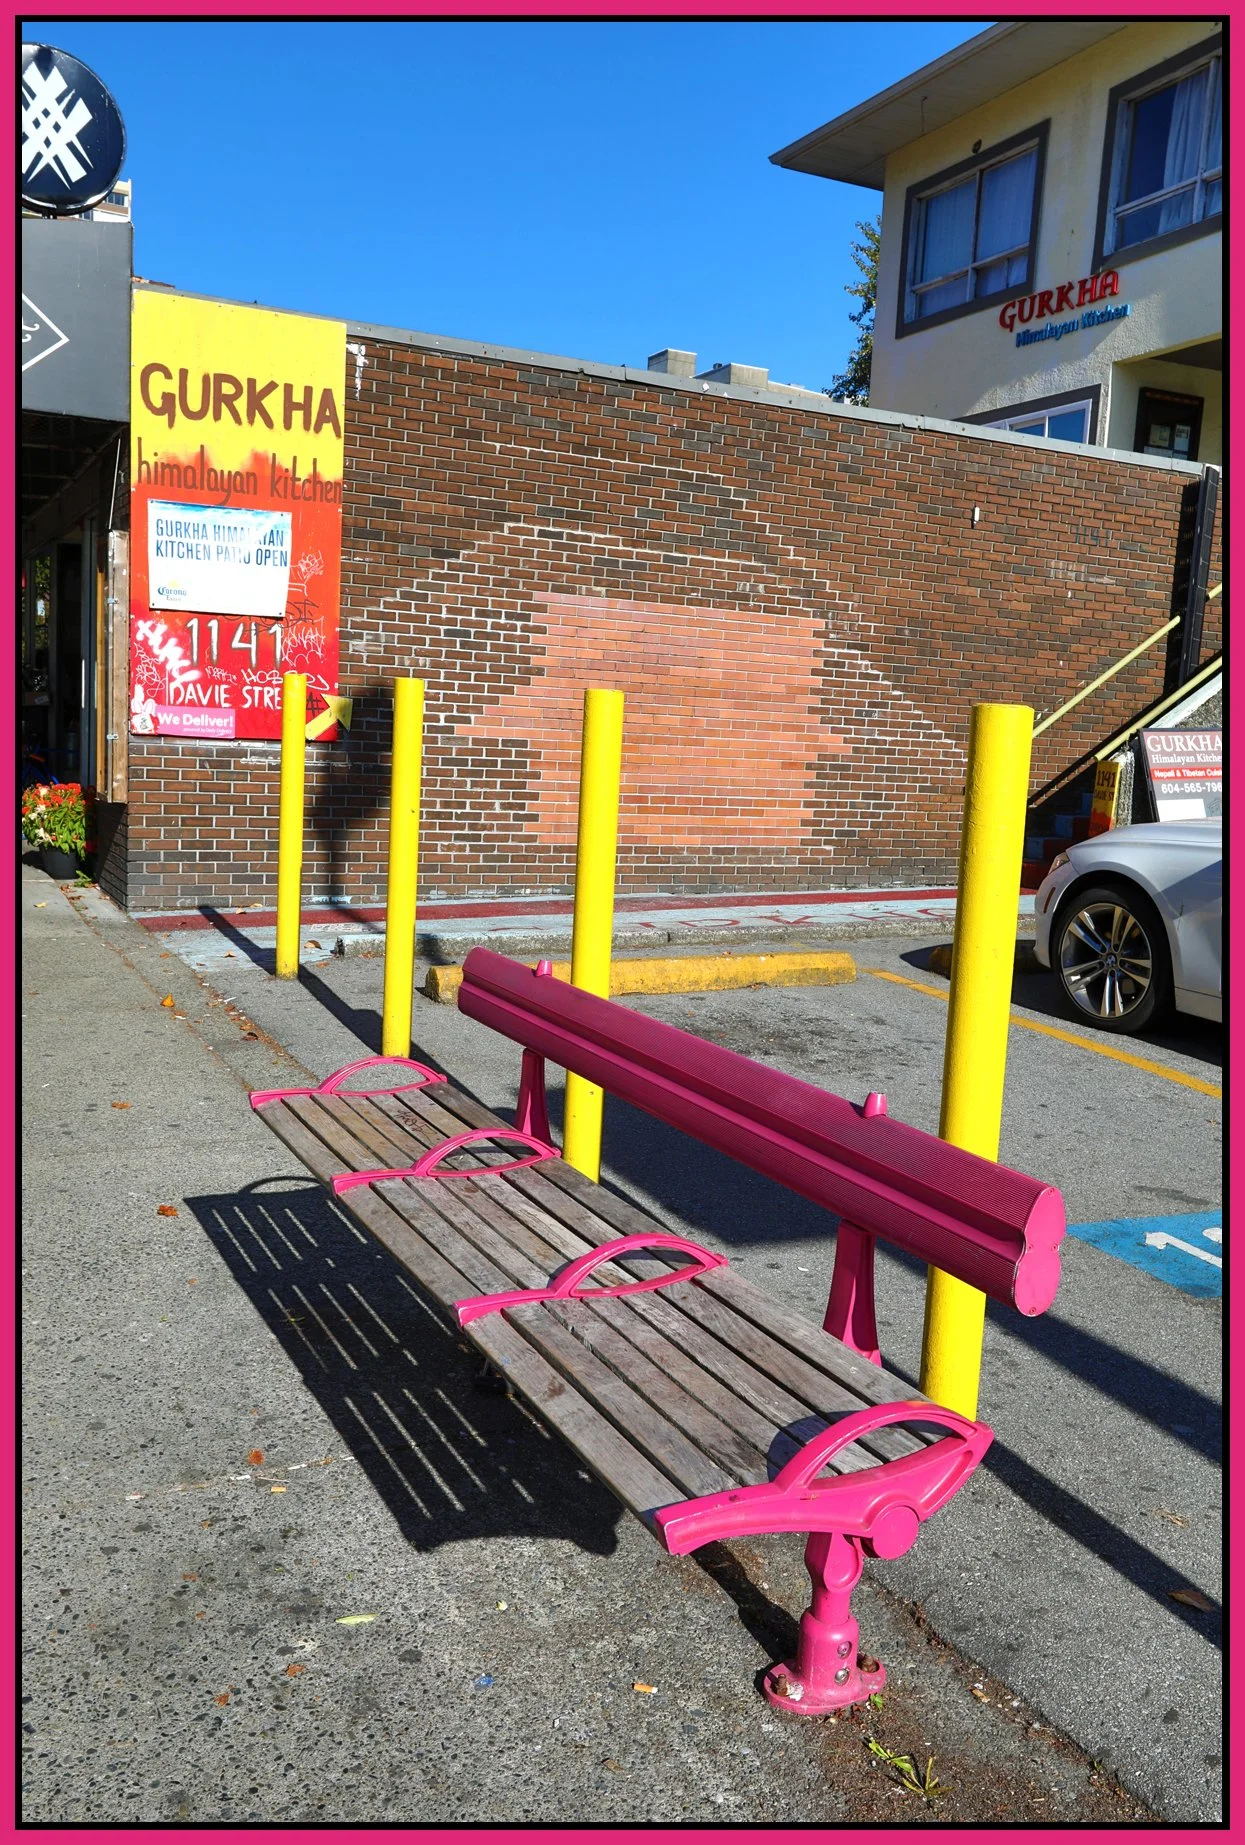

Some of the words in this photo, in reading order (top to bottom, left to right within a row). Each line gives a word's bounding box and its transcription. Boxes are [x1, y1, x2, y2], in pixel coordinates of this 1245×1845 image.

[999, 269, 1119, 332] GURKHA
[1016, 320, 1079, 347] Himalayan
[1080, 304, 1131, 329] Kitchen
[140, 362, 342, 439] GURKHA
[137, 436, 258, 505] himalayan
[270, 453, 342, 504] kitchen
[156, 518, 208, 540] GURKHA
[213, 524, 284, 547] HIMAYAN
[156, 540, 211, 561] KITCHEN
[255, 548, 288, 567] OPEN
[186, 617, 283, 669] 1141
[169, 683, 233, 708] DAVIE
[158, 712, 180, 724] We
[182, 713, 234, 728] Deliver!
[1146, 735, 1222, 752] GURKHA
[1151, 754, 1195, 765] Himalayan
